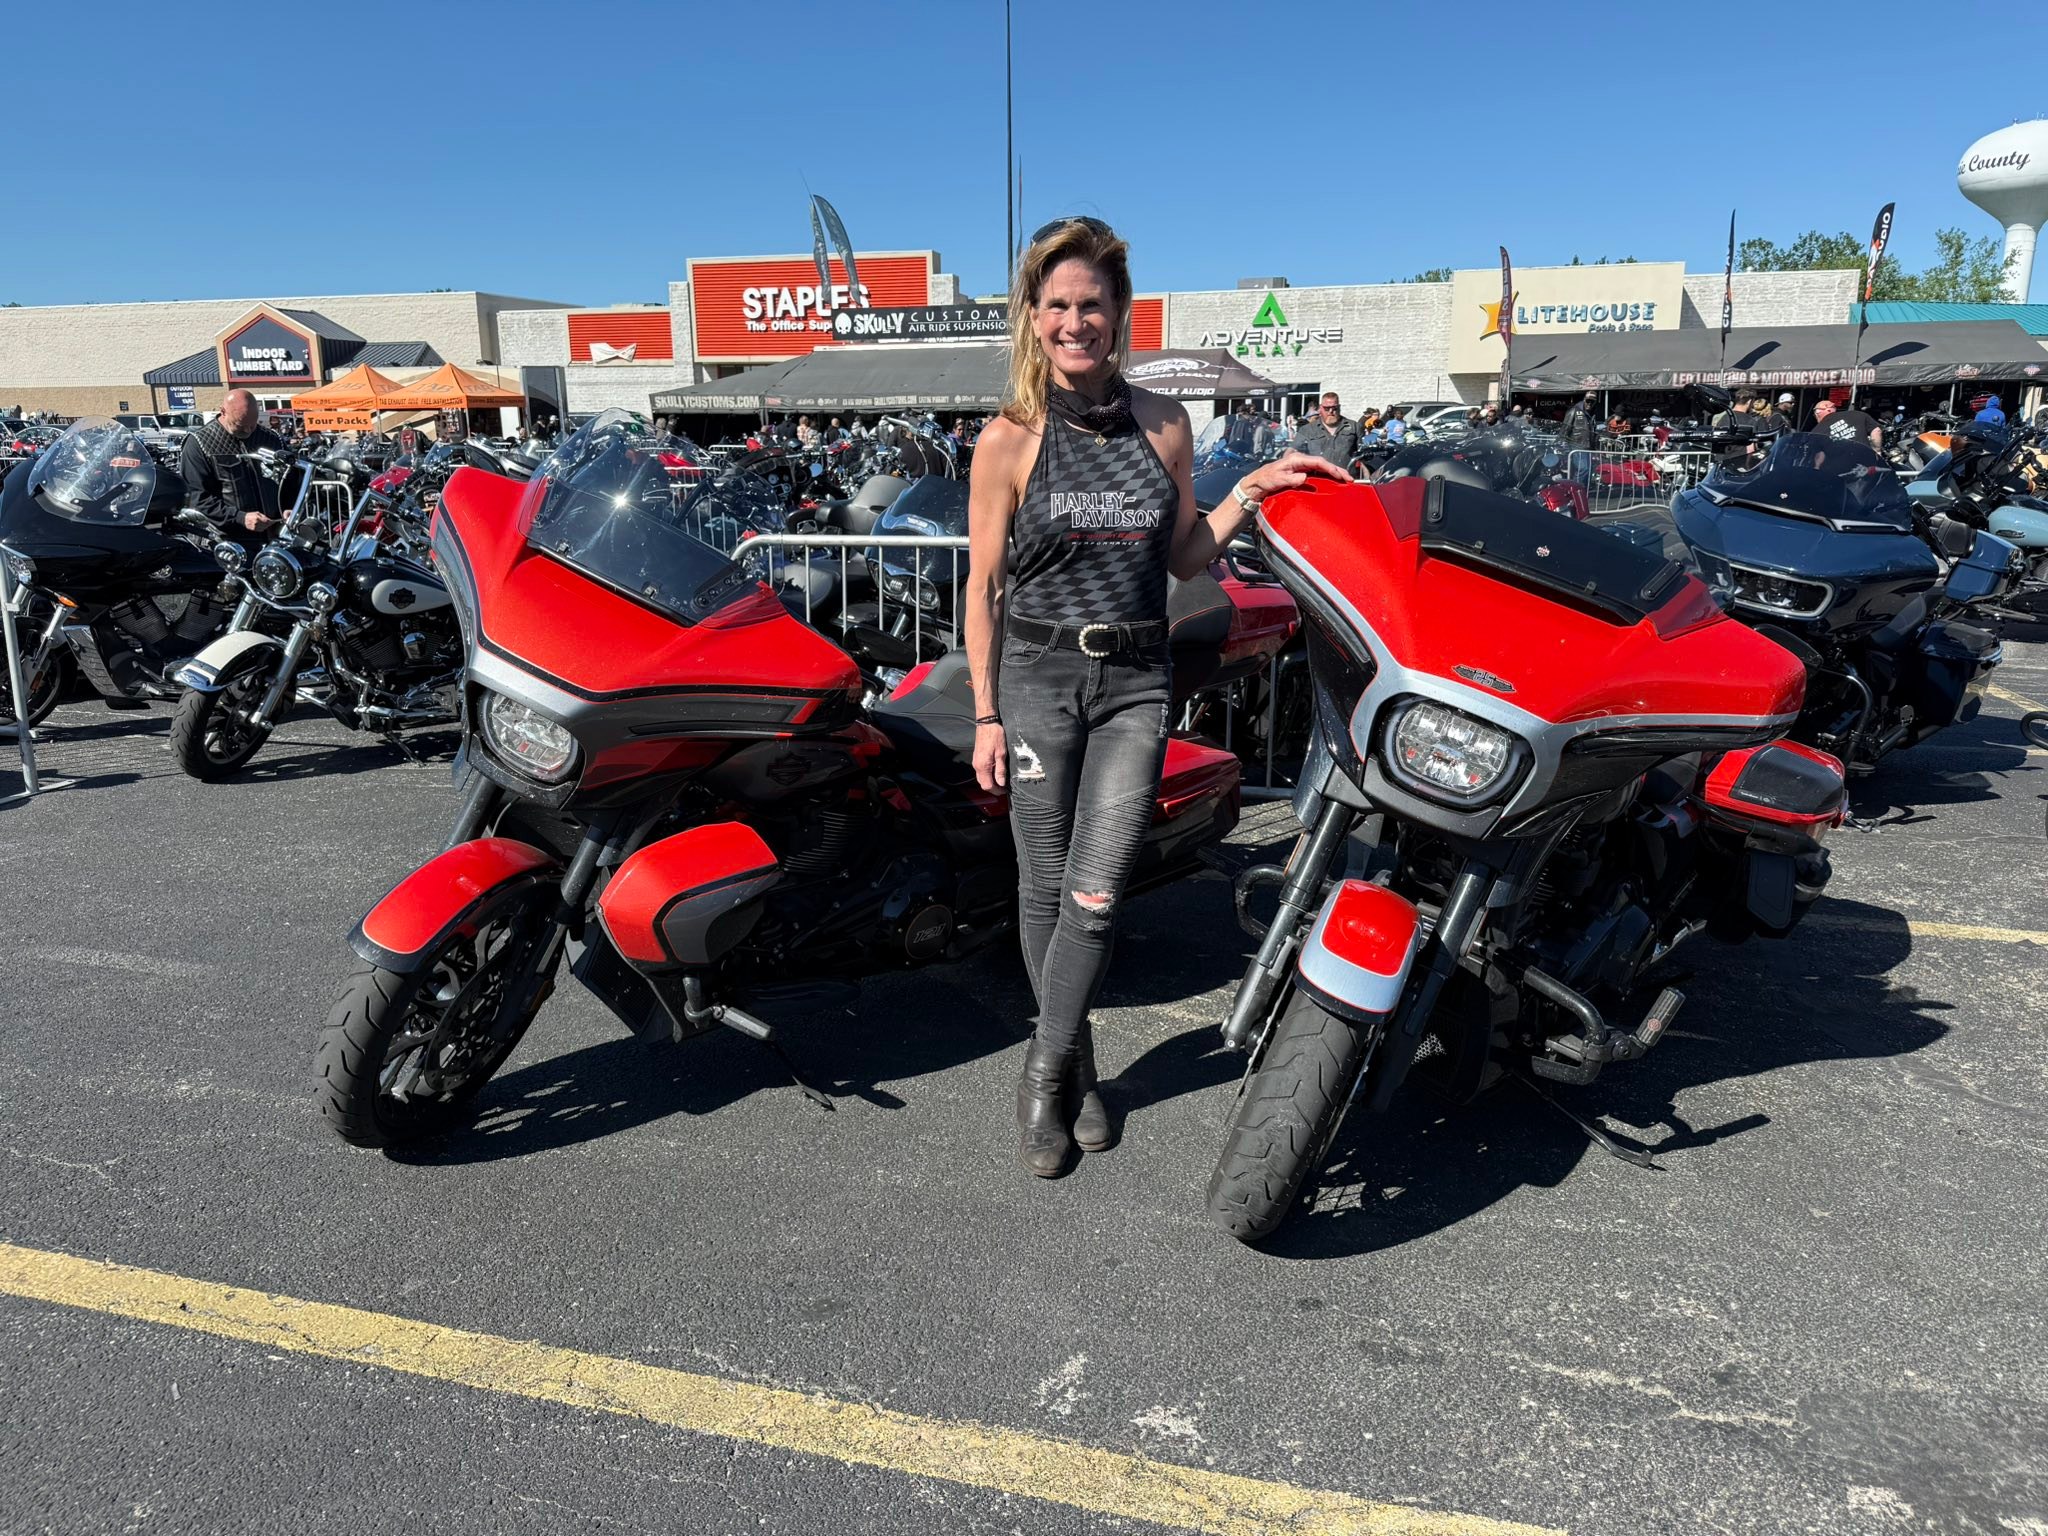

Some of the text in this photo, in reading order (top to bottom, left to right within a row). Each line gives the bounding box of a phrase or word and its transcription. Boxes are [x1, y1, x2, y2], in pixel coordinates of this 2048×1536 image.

[1968, 151, 2031, 172] County
[1517, 302, 1656, 324] LITEHOUSE
[746, 319, 833, 333] The Office Sup
[854, 312, 905, 334] SKULLY
[908, 321, 1007, 333] AIR RIDE SUSPENSIO
[1629, 322, 1654, 332] Spas
[1200, 328, 1344, 347] ADVENTURE
[242, 346, 287, 359] INDOOR
[1236, 343, 1304, 357] PLAY
[229, 358, 304, 372] LUMBER YARD
[1176, 371, 1220, 379] DEALER
[1672, 371, 1693, 387] LED
[1761, 370, 1838, 386] MOTORCYCLE
[1149, 387, 1216, 396] YCLE AUDIO
[654, 395, 760, 409] SKULLYCUSTOMS.COM
[308, 415, 369, 426] Tour Packs
[1071, 509, 1160, 528] DAVIDSON
